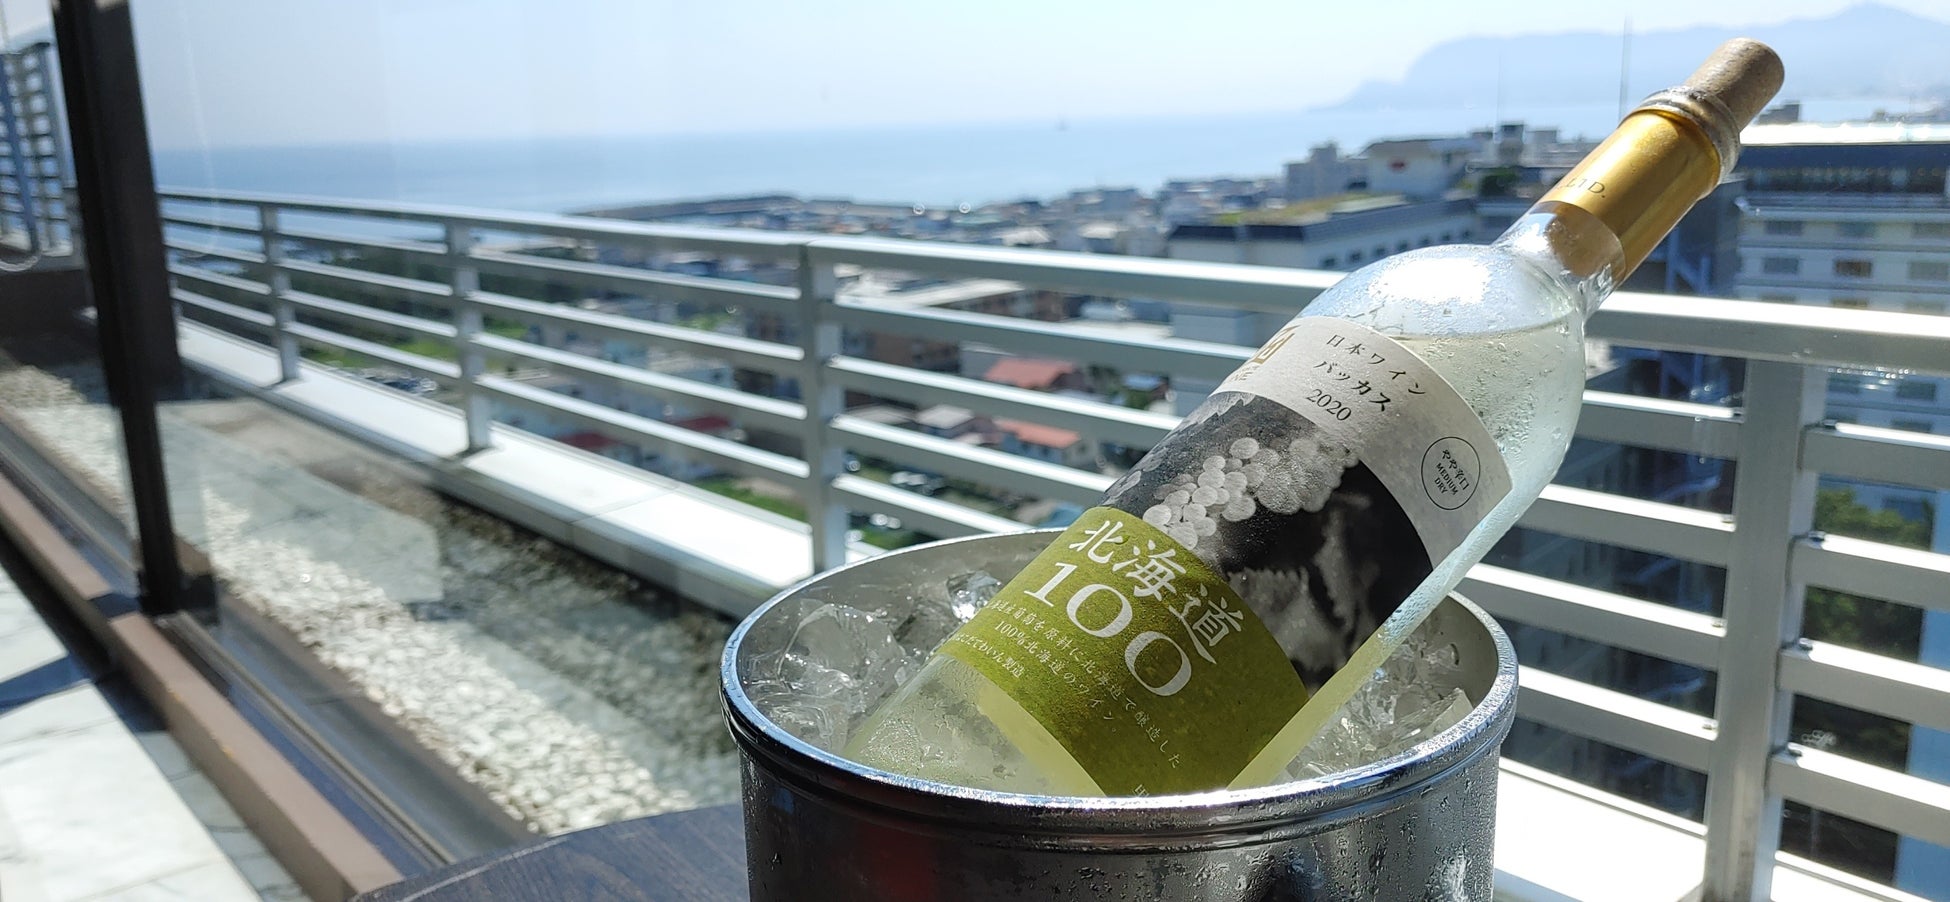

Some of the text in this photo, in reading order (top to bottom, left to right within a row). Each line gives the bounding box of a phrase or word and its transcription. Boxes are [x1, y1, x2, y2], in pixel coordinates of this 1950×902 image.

[1313, 360, 1392, 412] バッカス
[1326, 334, 1426, 396] 日本ワイン
[1306, 388, 1352, 422] 2020
[1433, 477, 1449, 494] DRY
[1435, 462, 1459, 496] MEDIUM
[1441, 449, 1470, 491] やや辛口
[1068, 519, 1245, 665] 北海道
[1023, 561, 1193, 697] 100
